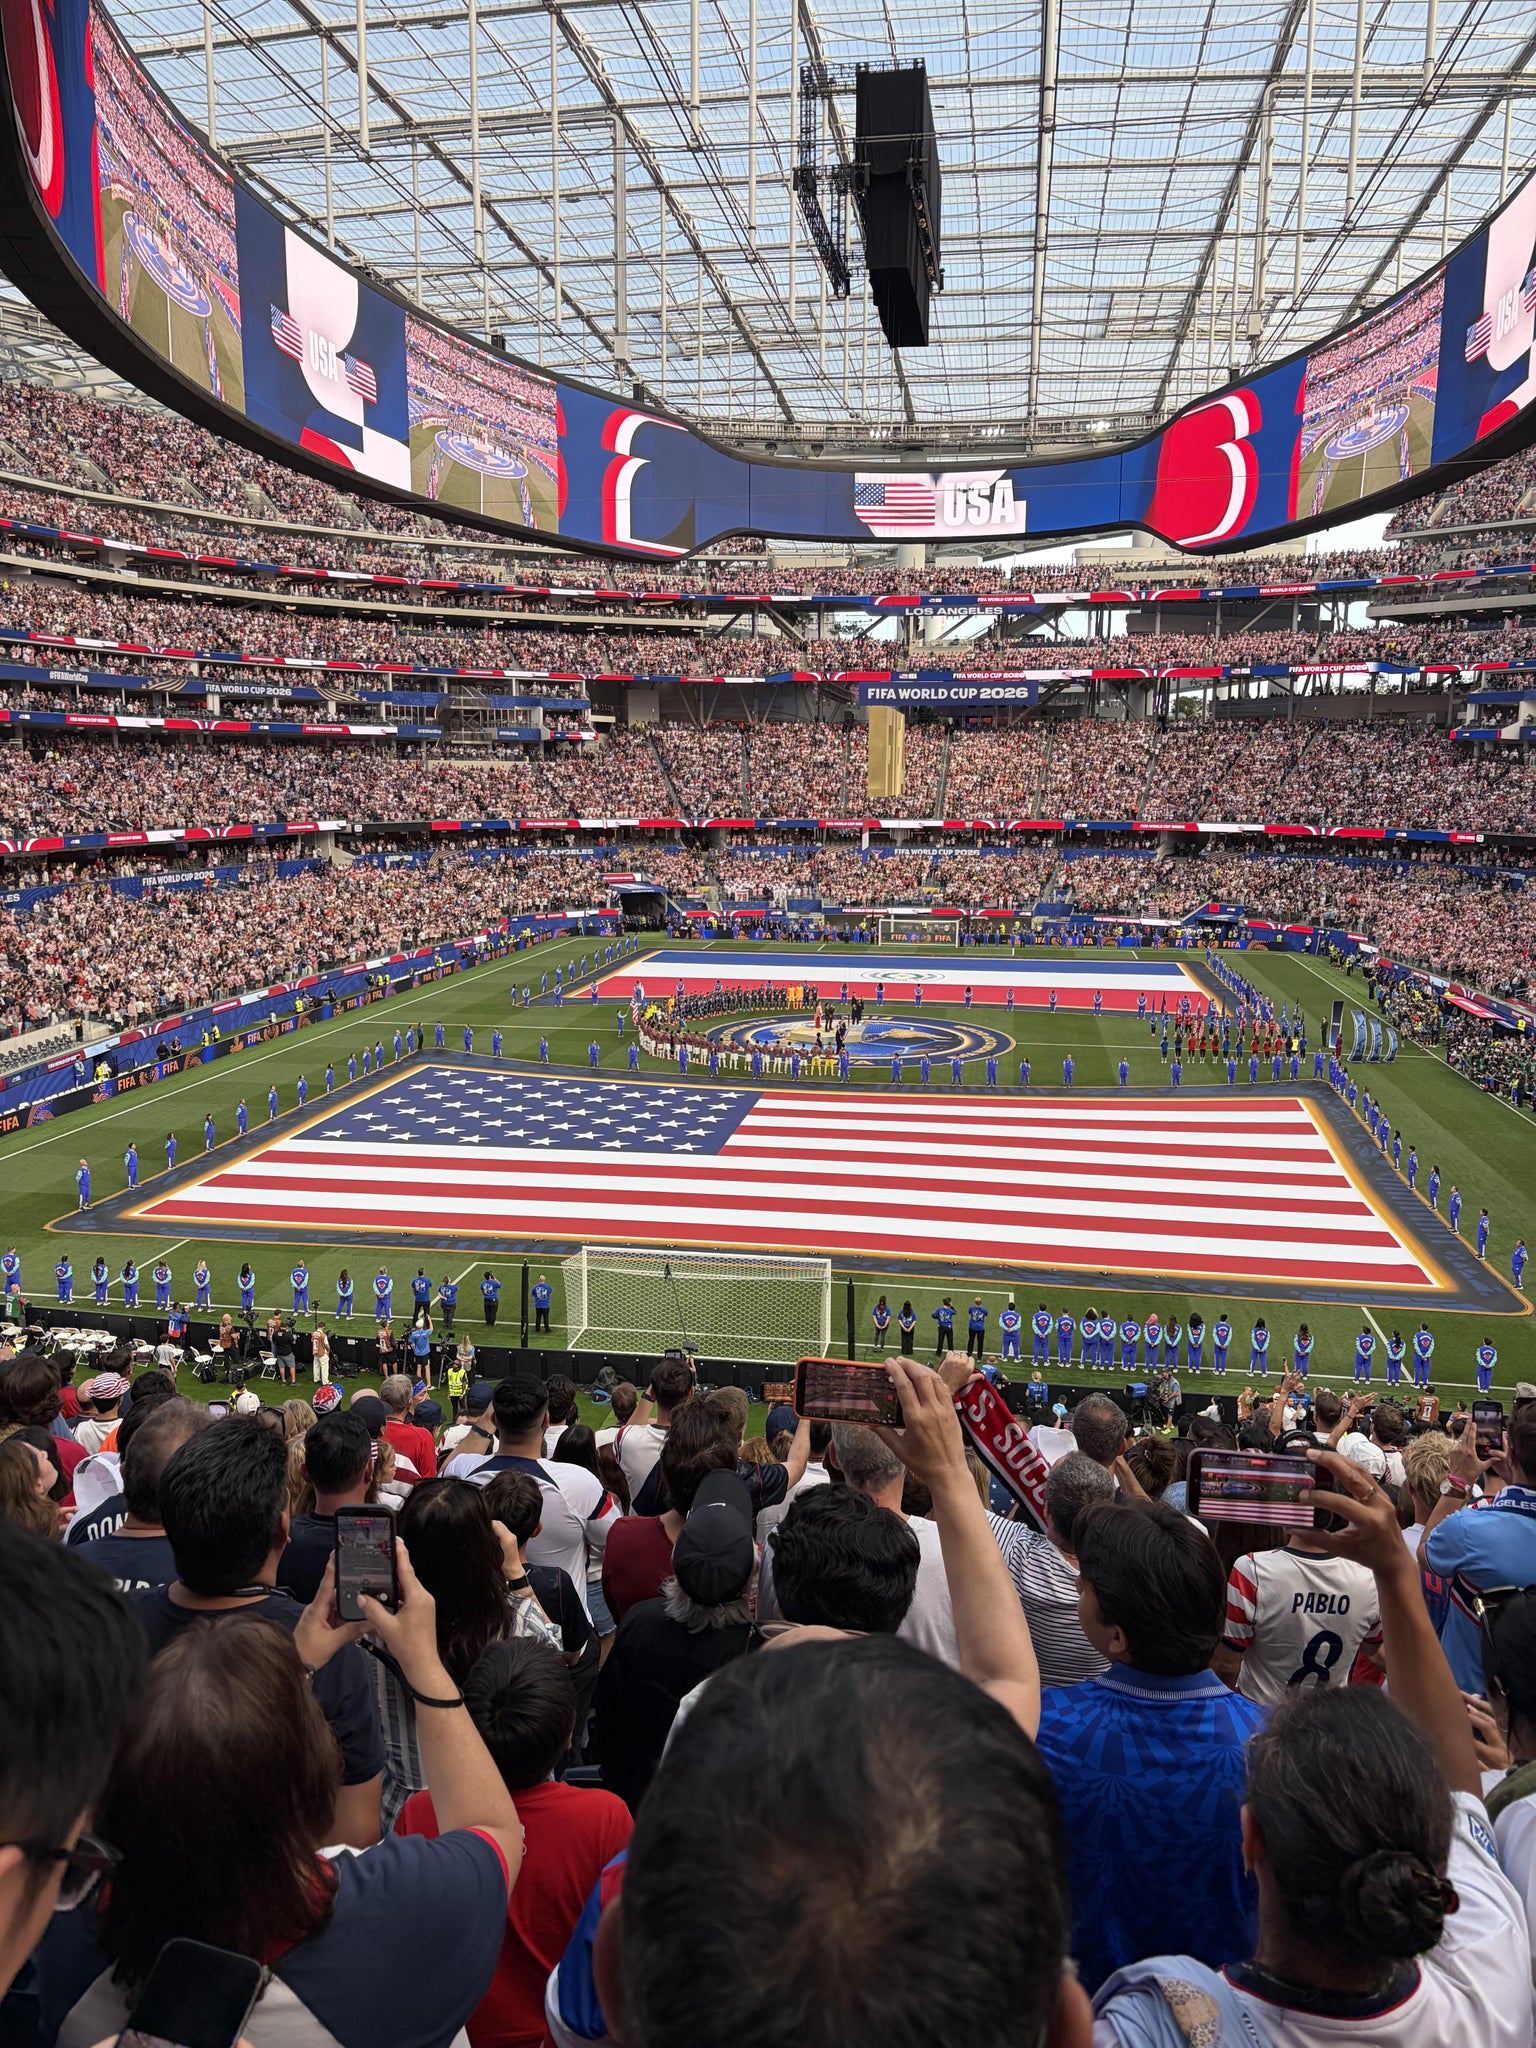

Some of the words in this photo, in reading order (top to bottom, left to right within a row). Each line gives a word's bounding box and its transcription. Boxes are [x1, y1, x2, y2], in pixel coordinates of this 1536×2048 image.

[1496, 282, 1520, 341] USA
[309, 329, 338, 383] USA
[943, 479, 1016, 527] USA
[905, 607, 936, 616] LOS
[937, 607, 1003, 616] ANGELES
[49, 670, 89, 684] #FIFAWorldCup
[205, 684, 221, 692] FIFA
[221, 684, 249, 694] WORLD
[250, 686, 265, 695] CUP
[266, 688, 292, 696] 2026
[867, 688, 897, 700] FIFA
[898, 688, 948, 700] WORLD
[949, 687, 978, 699] CUP
[979, 687, 1029, 699] 2026
[550, 848, 594, 856] ANGELES
[910, 848, 937, 856] WORLD
[142, 877, 157, 886] FIFA
[157, 875, 181, 885] WORLD
[182, 872, 194, 882] CUP
[194, 870, 215, 879] 2026
[891, 933, 908, 941] FIFA
[934, 934, 951, 942] FIFA
[1076, 936, 1093, 945] FFA
[1222, 940, 1240, 948] FIFA
[281, 1020, 294, 1032] FIFA
[247, 1032, 261, 1044] FIFA
[162, 1060, 179, 1075] FIFA
[117, 1075, 136, 1091] FIFA
[1291, 1592, 1351, 1616] PABLO
[1286, 1630, 1343, 1689] 8
